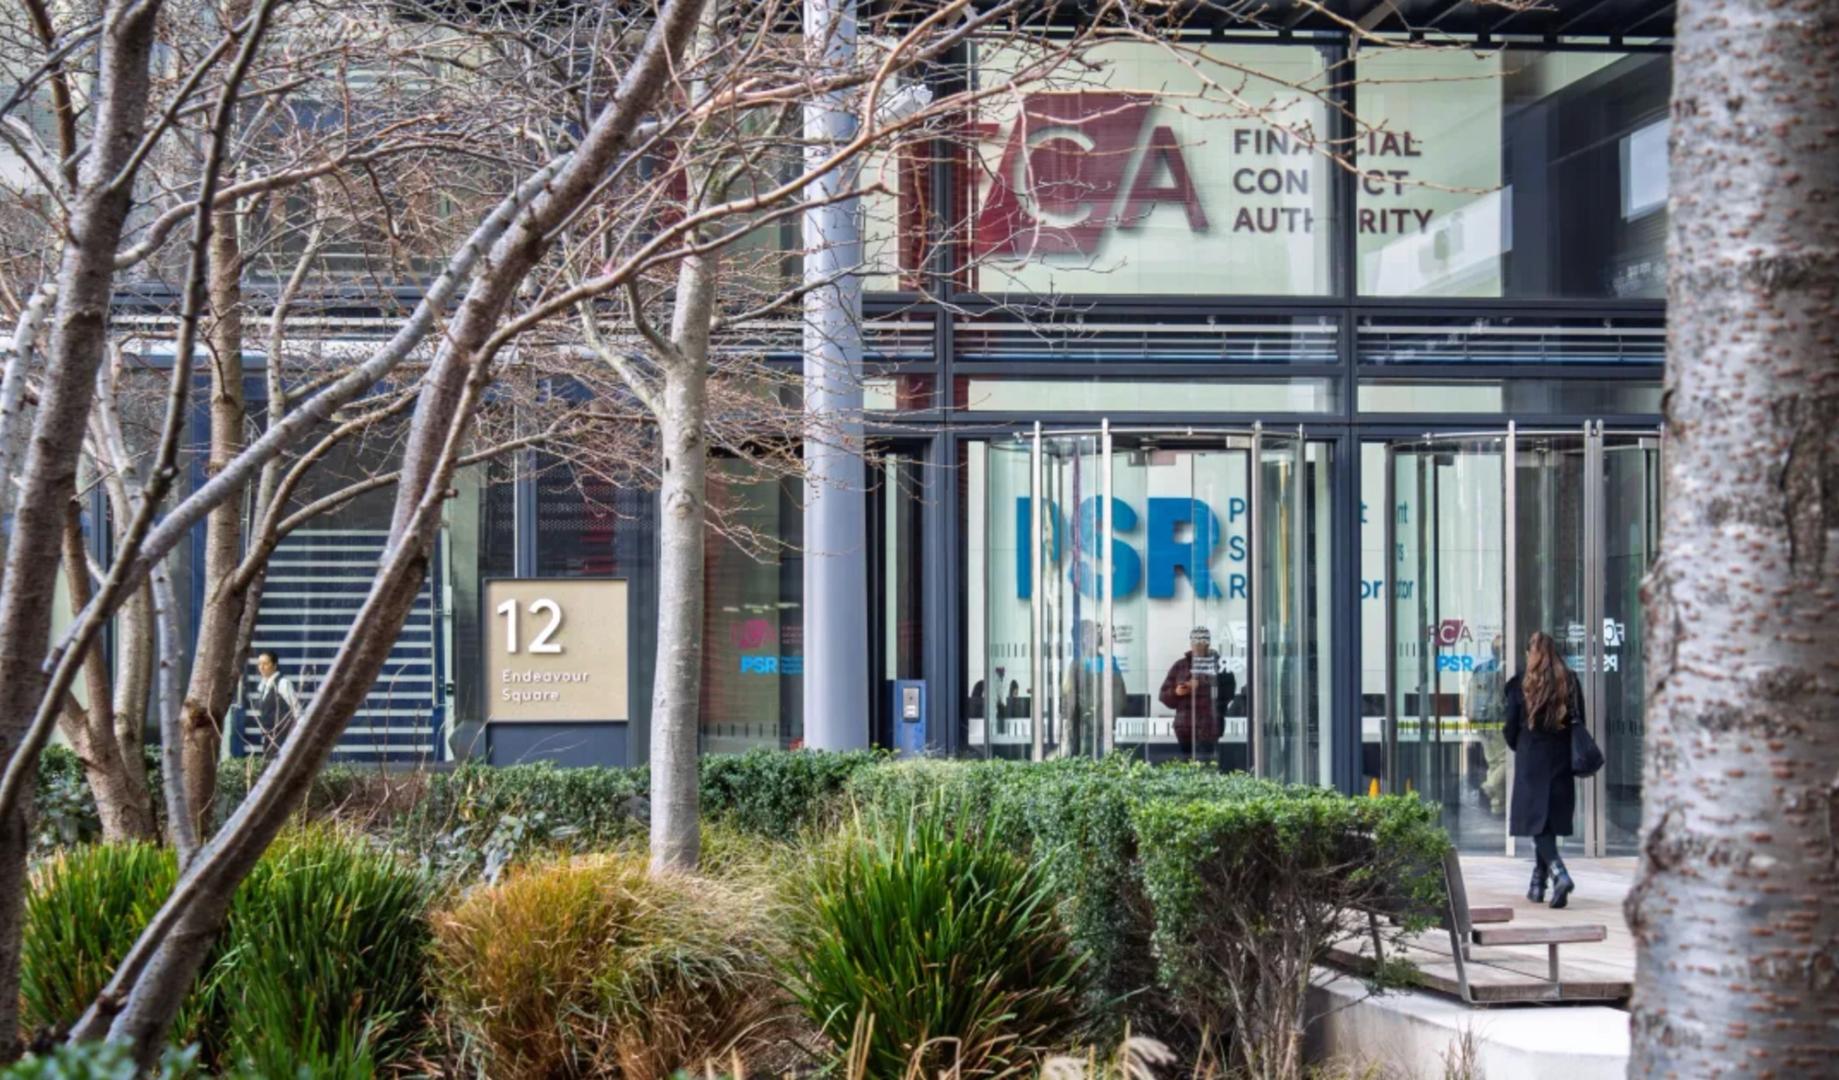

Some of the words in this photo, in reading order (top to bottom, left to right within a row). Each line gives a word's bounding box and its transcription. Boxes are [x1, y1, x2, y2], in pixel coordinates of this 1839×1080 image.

[1233, 168, 1409, 196] CONCT
[497, 598, 563, 653] 12
[741, 656, 777, 673] PSR
[1436, 655, 1473, 672] PSR
[502, 669, 590, 683] Endeavour
[502, 690, 561, 704] Square
